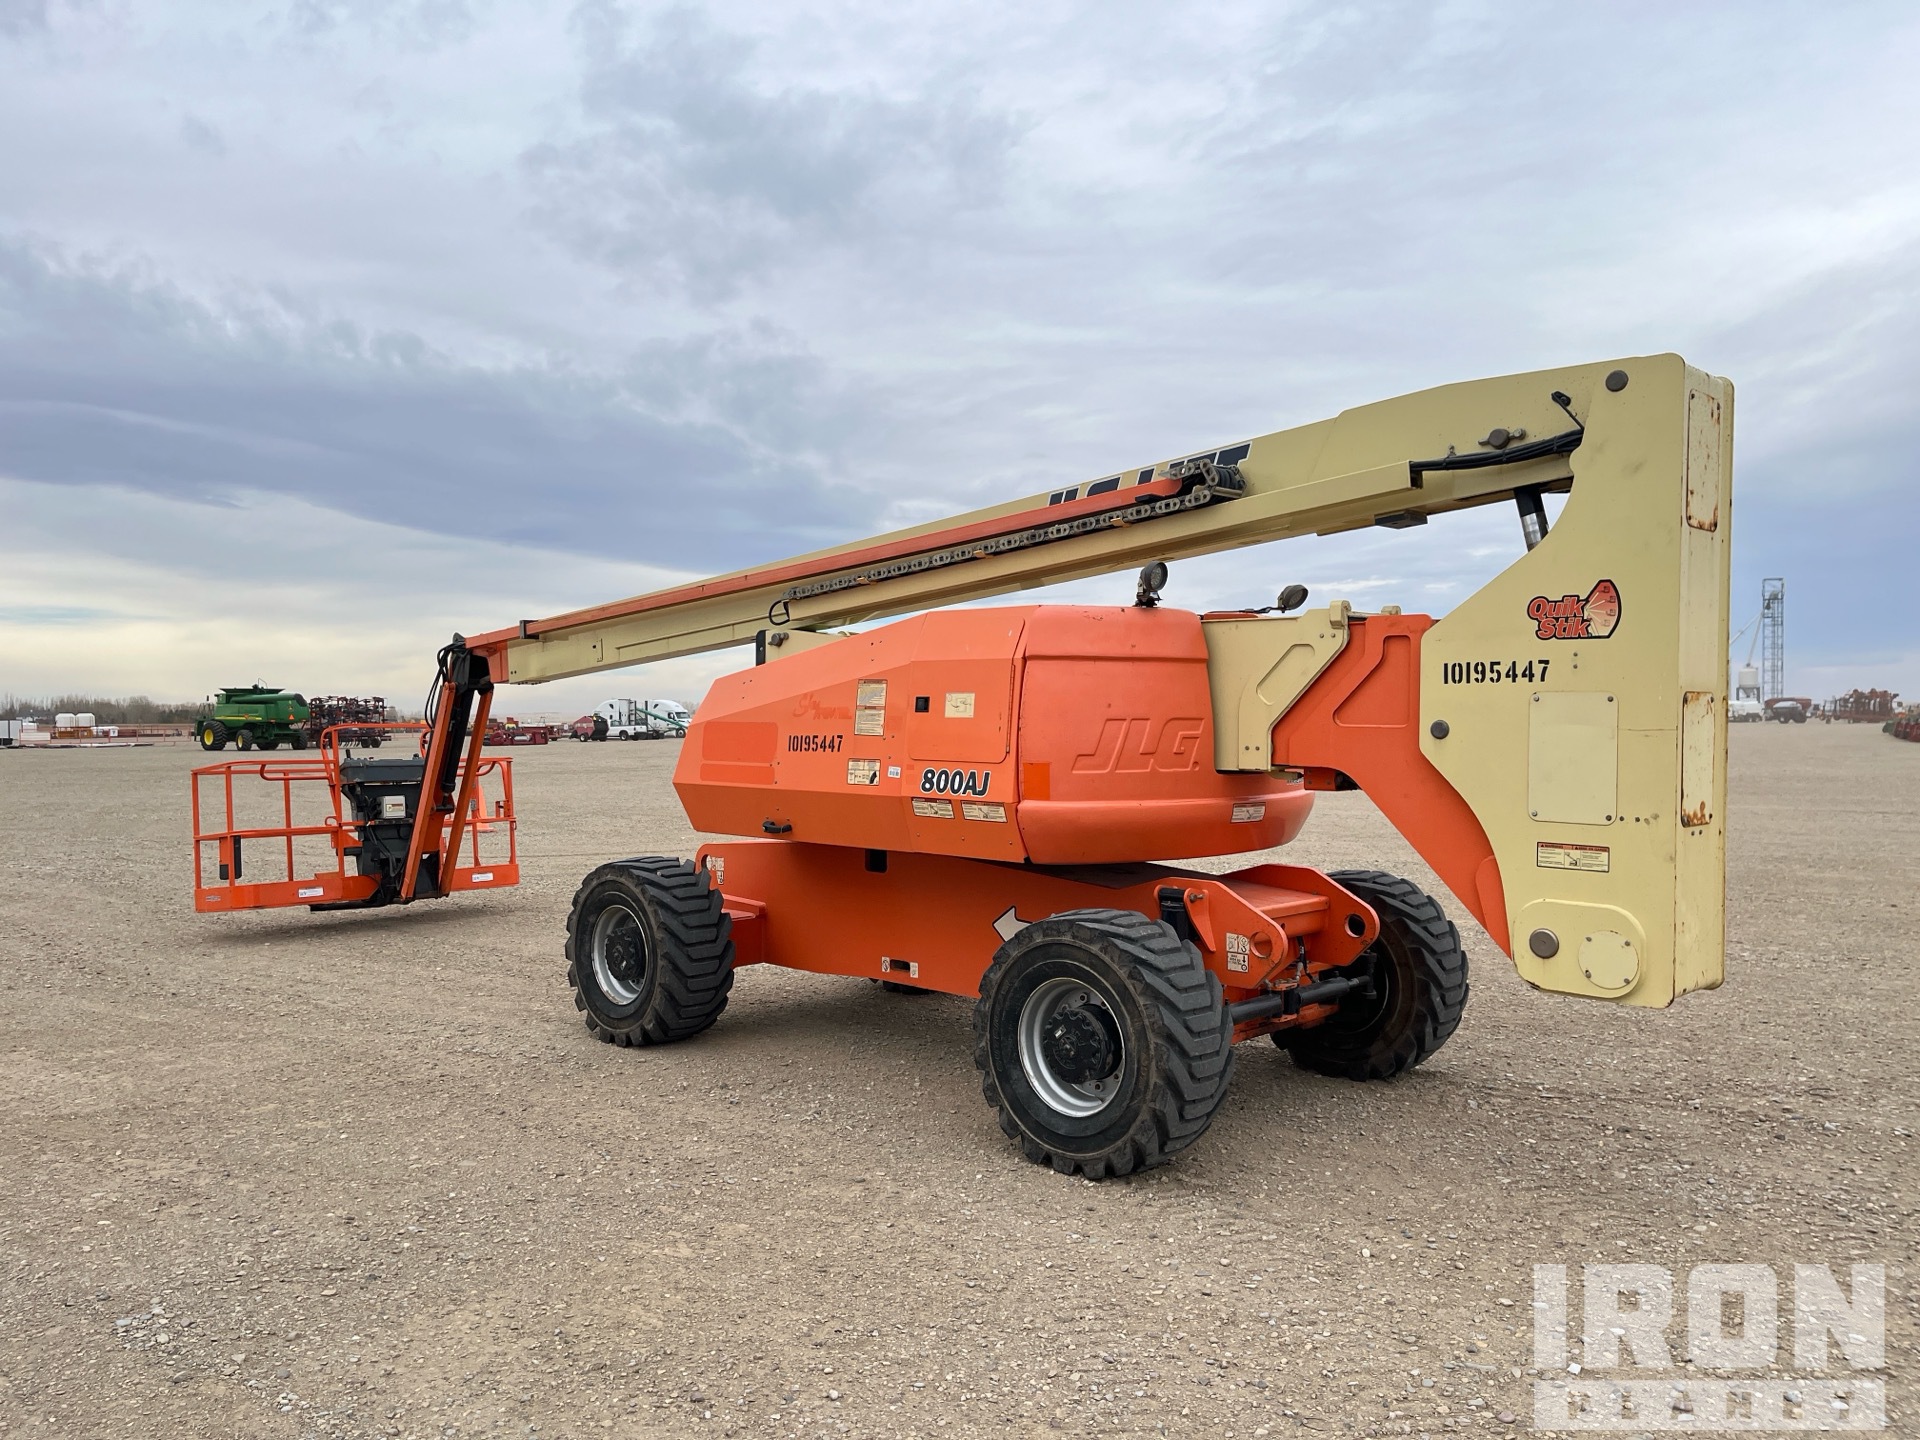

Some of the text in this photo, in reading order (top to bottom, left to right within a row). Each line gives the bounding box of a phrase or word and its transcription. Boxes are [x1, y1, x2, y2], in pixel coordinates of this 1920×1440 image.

[1529, 596, 1586, 619] Quik
[1538, 617, 1591, 639] Stik
[1443, 659, 1550, 685] 10195447
[787, 734, 844, 753] 10195447
[1072, 717, 1205, 773] JLG
[920, 767, 991, 798] 800AJ
